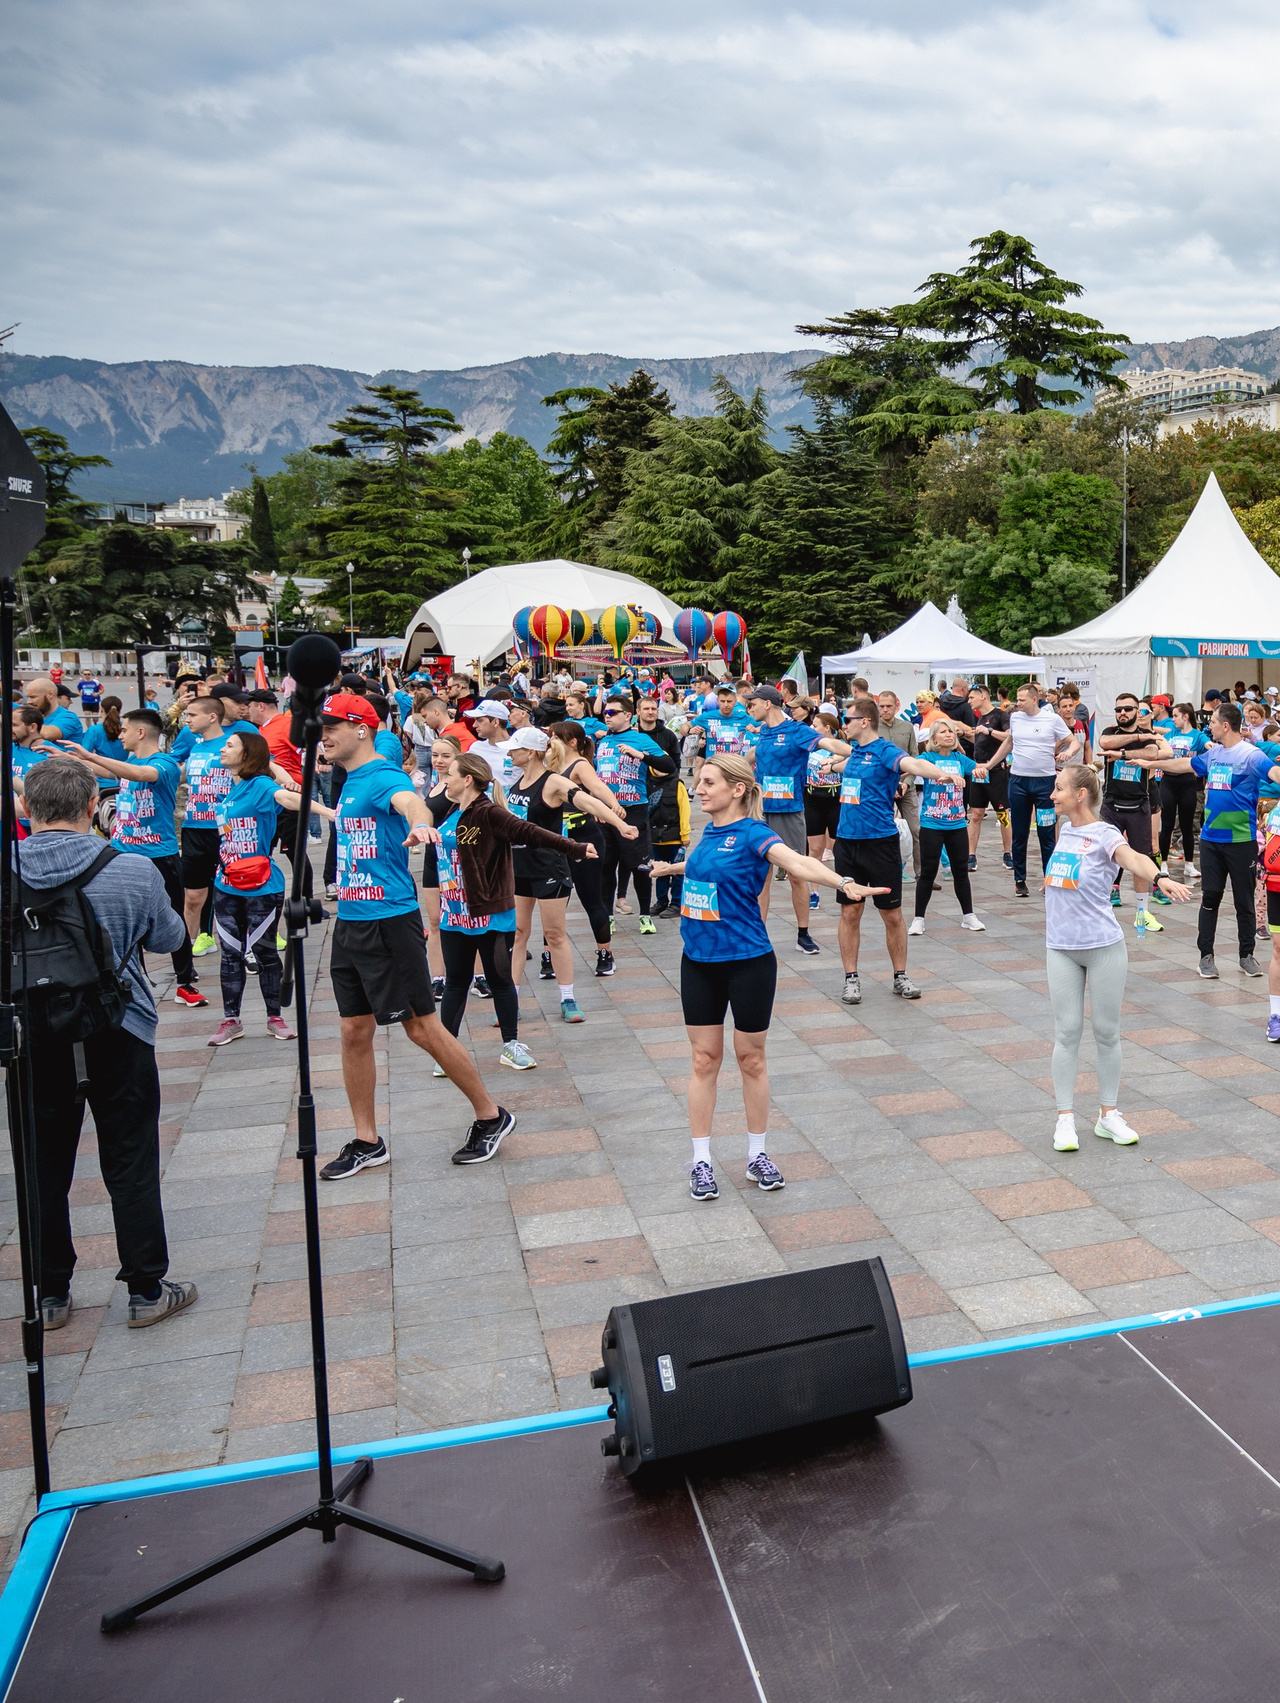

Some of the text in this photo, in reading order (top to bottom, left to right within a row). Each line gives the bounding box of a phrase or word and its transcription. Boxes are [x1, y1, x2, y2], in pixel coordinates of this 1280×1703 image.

[8, 477, 33, 493] SHURE
[1198, 642, 1249, 656] ГРАВИРОВКА
[1056, 677, 1066, 690] 5
[619, 785, 636, 793] 2024
[768, 783, 788, 791] 20254
[232, 829, 258, 841] 2024
[1051, 863, 1072, 877] 20251
[349, 873, 373, 887] 2024
[1052, 877, 1063, 887] 5KM
[684, 891, 709, 908] 20252
[690, 908, 702, 919] 5KM
[660, 1359, 673, 1386] FBT
